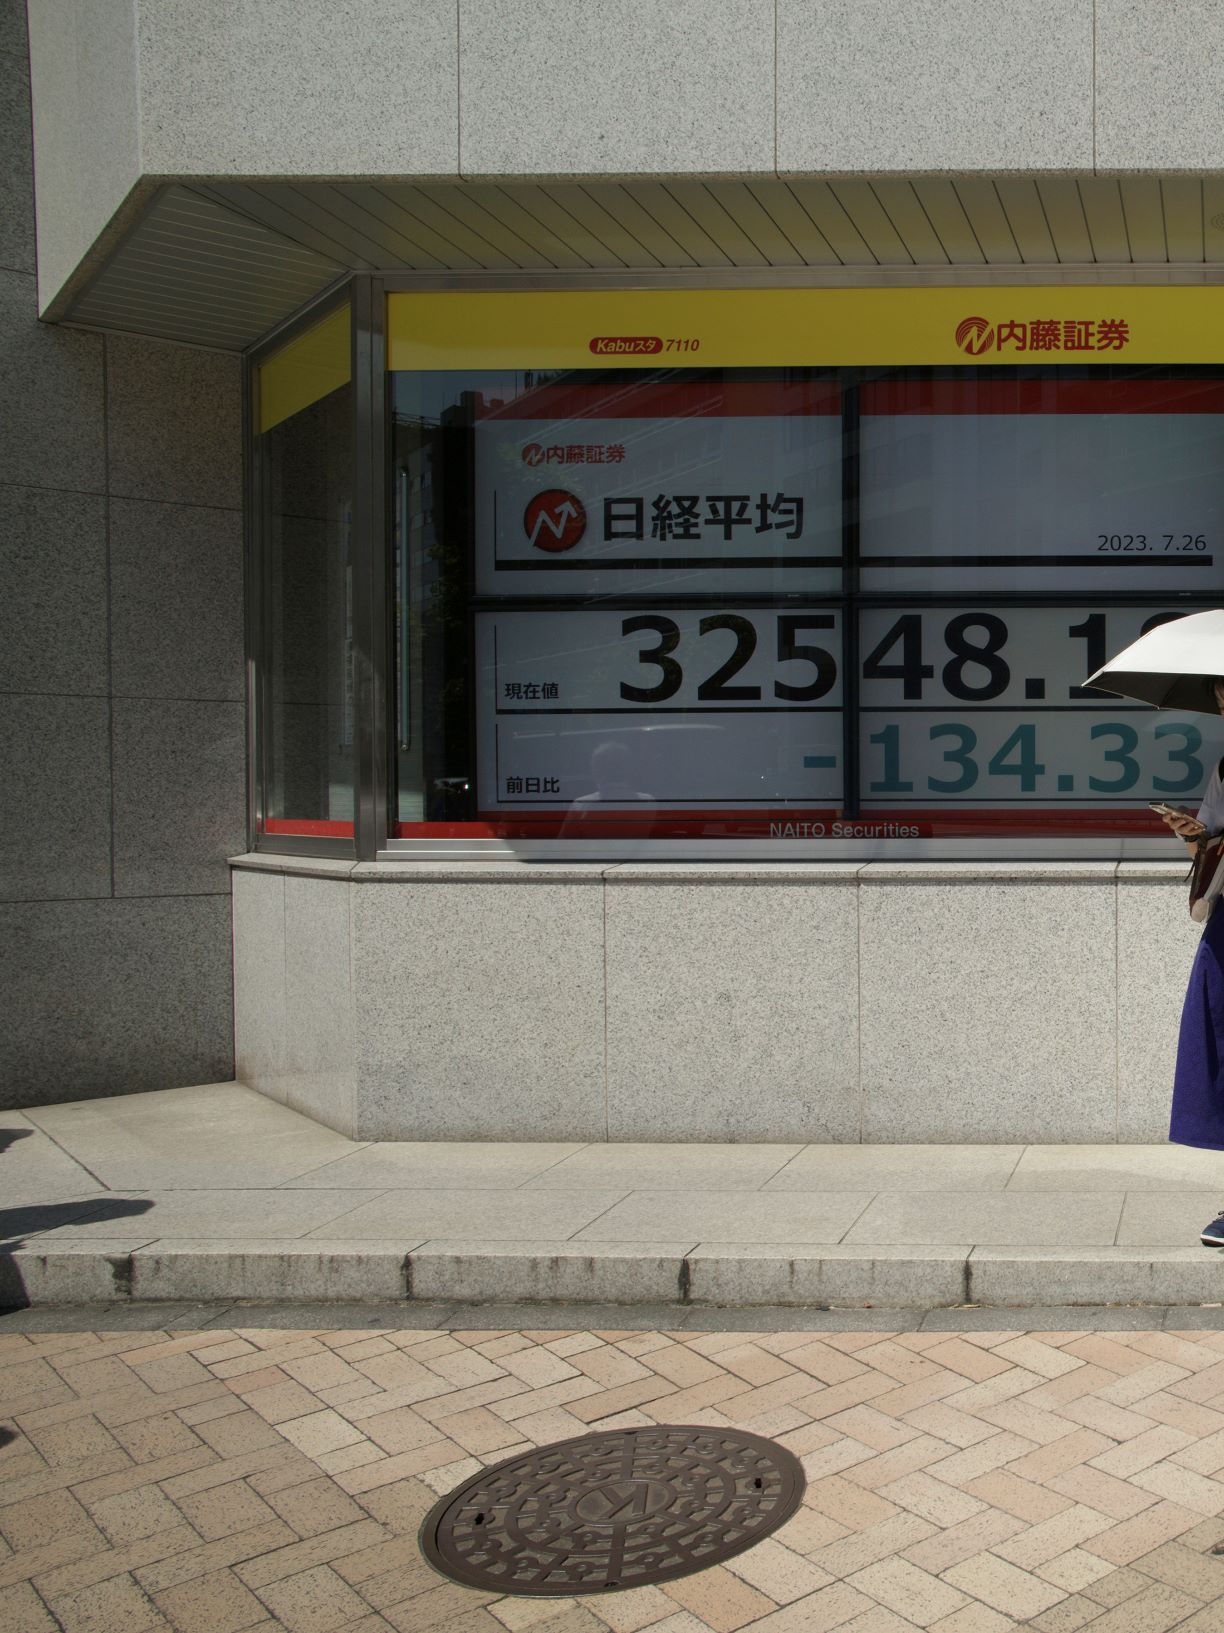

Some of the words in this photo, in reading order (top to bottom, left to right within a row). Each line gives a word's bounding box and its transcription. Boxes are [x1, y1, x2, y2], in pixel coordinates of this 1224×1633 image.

[595, 338, 657, 353] Kabuスタ
[665, 338, 700, 352] 7110
[997, 319, 1130, 352] 内藤証券
[546, 443, 626, 465] 内藤証券
[602, 492, 805, 541] 日経平均
[619, 612, 1190, 702] 32548.1
[504, 681, 560, 701] 現在値
[803, 722, 1205, 794] -134.33
[505, 776, 561, 794] 前日比
[769, 823, 826, 838] NAITO
[831, 822, 920, 838] Securities
